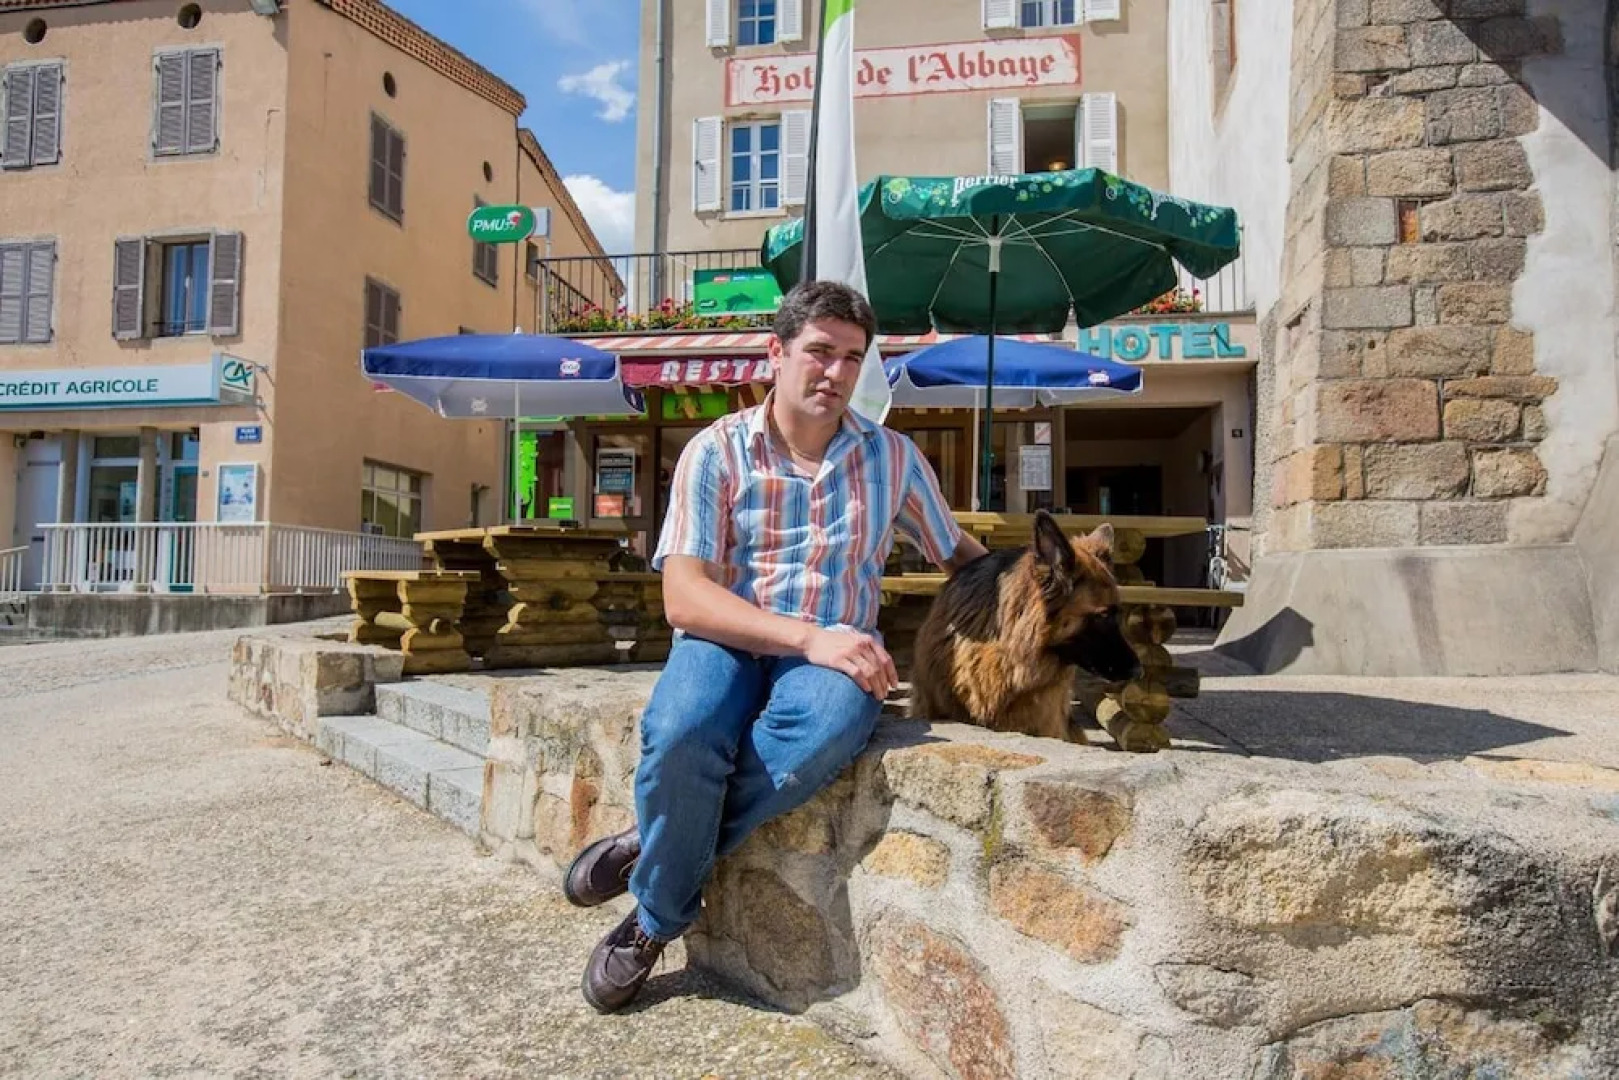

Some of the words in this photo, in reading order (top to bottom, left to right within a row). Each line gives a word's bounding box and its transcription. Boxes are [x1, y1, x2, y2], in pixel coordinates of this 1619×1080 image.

[753, 64, 816, 99] Hot
[857, 59, 892, 86] de
[908, 52, 1056, 83] l'Abbaye
[472, 219, 505, 232] PMU
[1078, 322, 1246, 361] HOTEL
[66, 378, 159, 394] AGRICOLE
